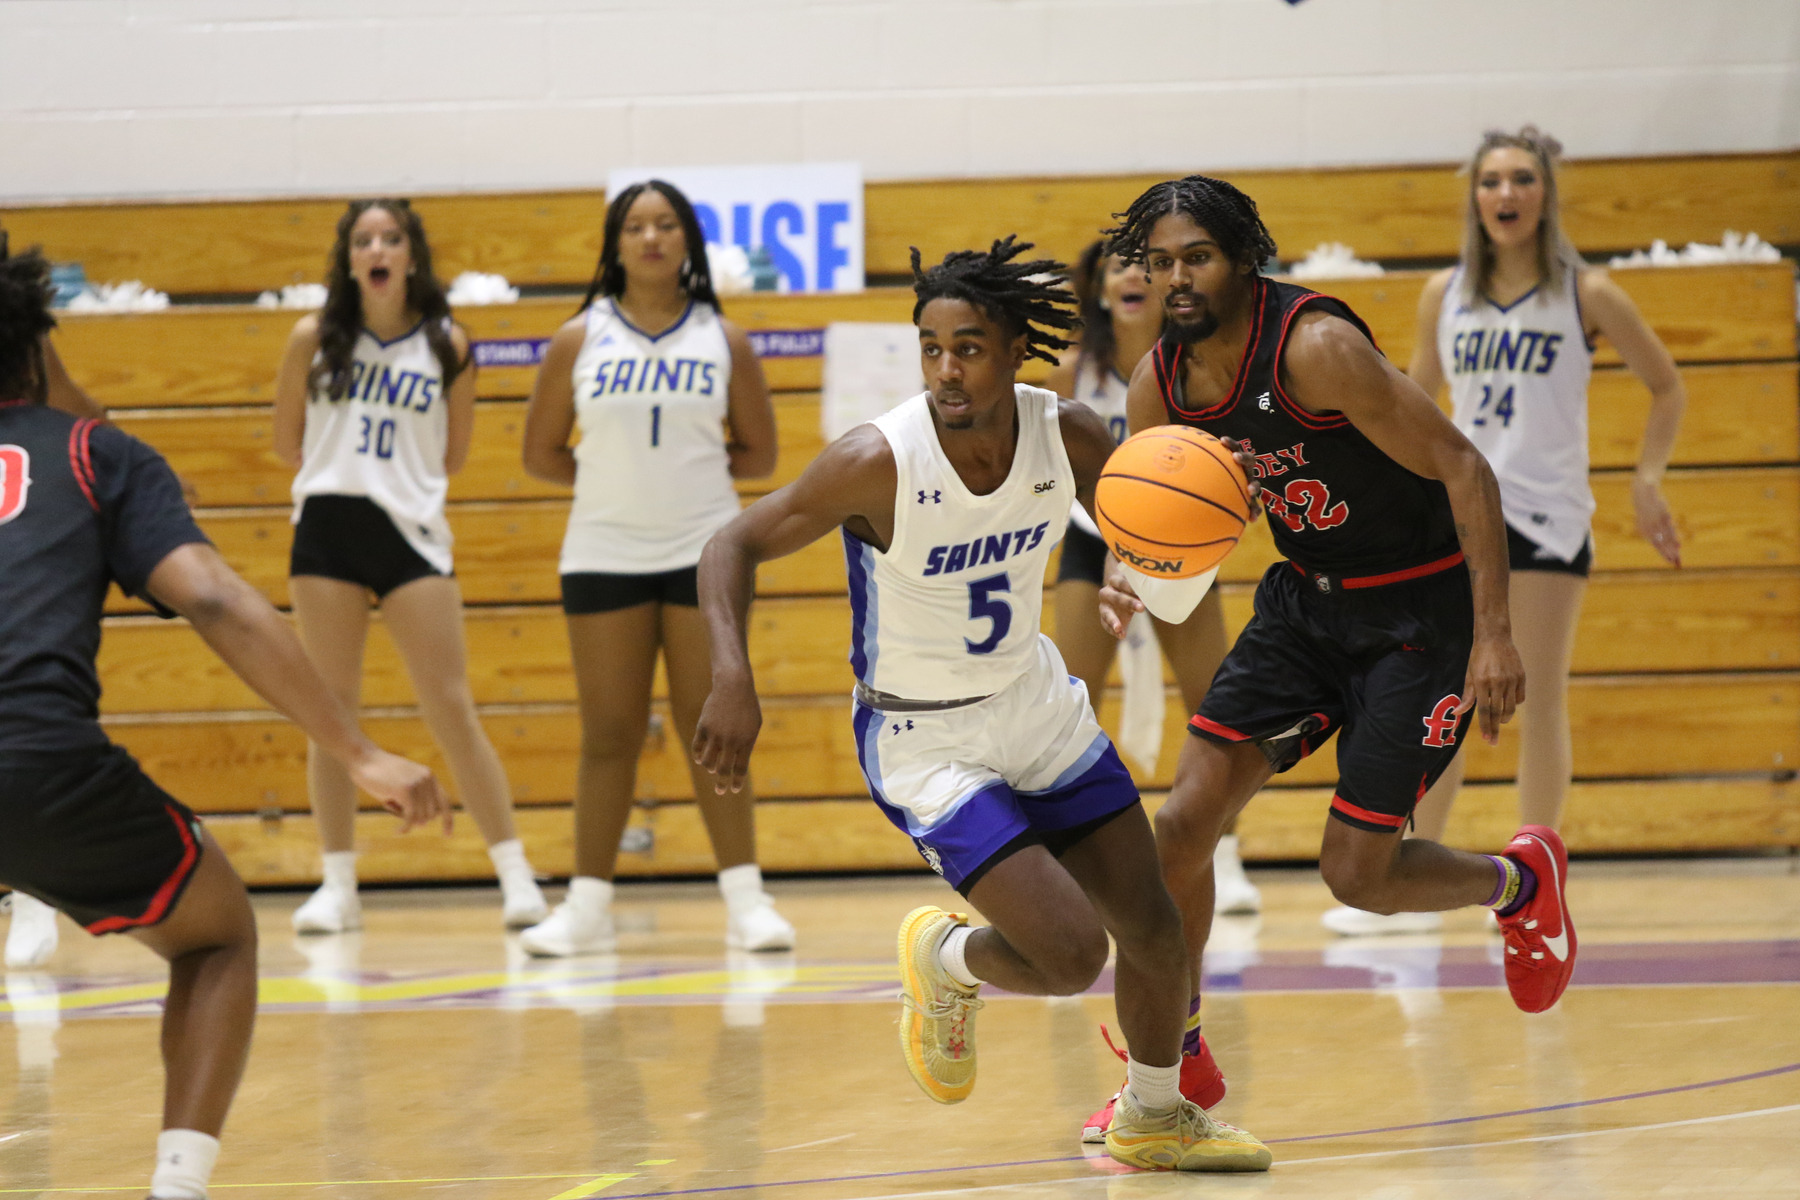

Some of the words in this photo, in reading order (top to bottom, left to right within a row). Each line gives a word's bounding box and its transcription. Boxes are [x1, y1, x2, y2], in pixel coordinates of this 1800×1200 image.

[1453, 329, 1563, 374] SAINTS
[346, 360, 438, 413] AINTS
[591, 358, 716, 399] SAINTS
[651, 405, 662, 447] 1
[1473, 385, 1515, 428] 24
[356, 415, 396, 459] 30
[1034, 480, 1056, 494] SAC
[922, 519, 1051, 577] SAINTS
[1114, 541, 1183, 573] NCAA
[963, 570, 1014, 655] 5
